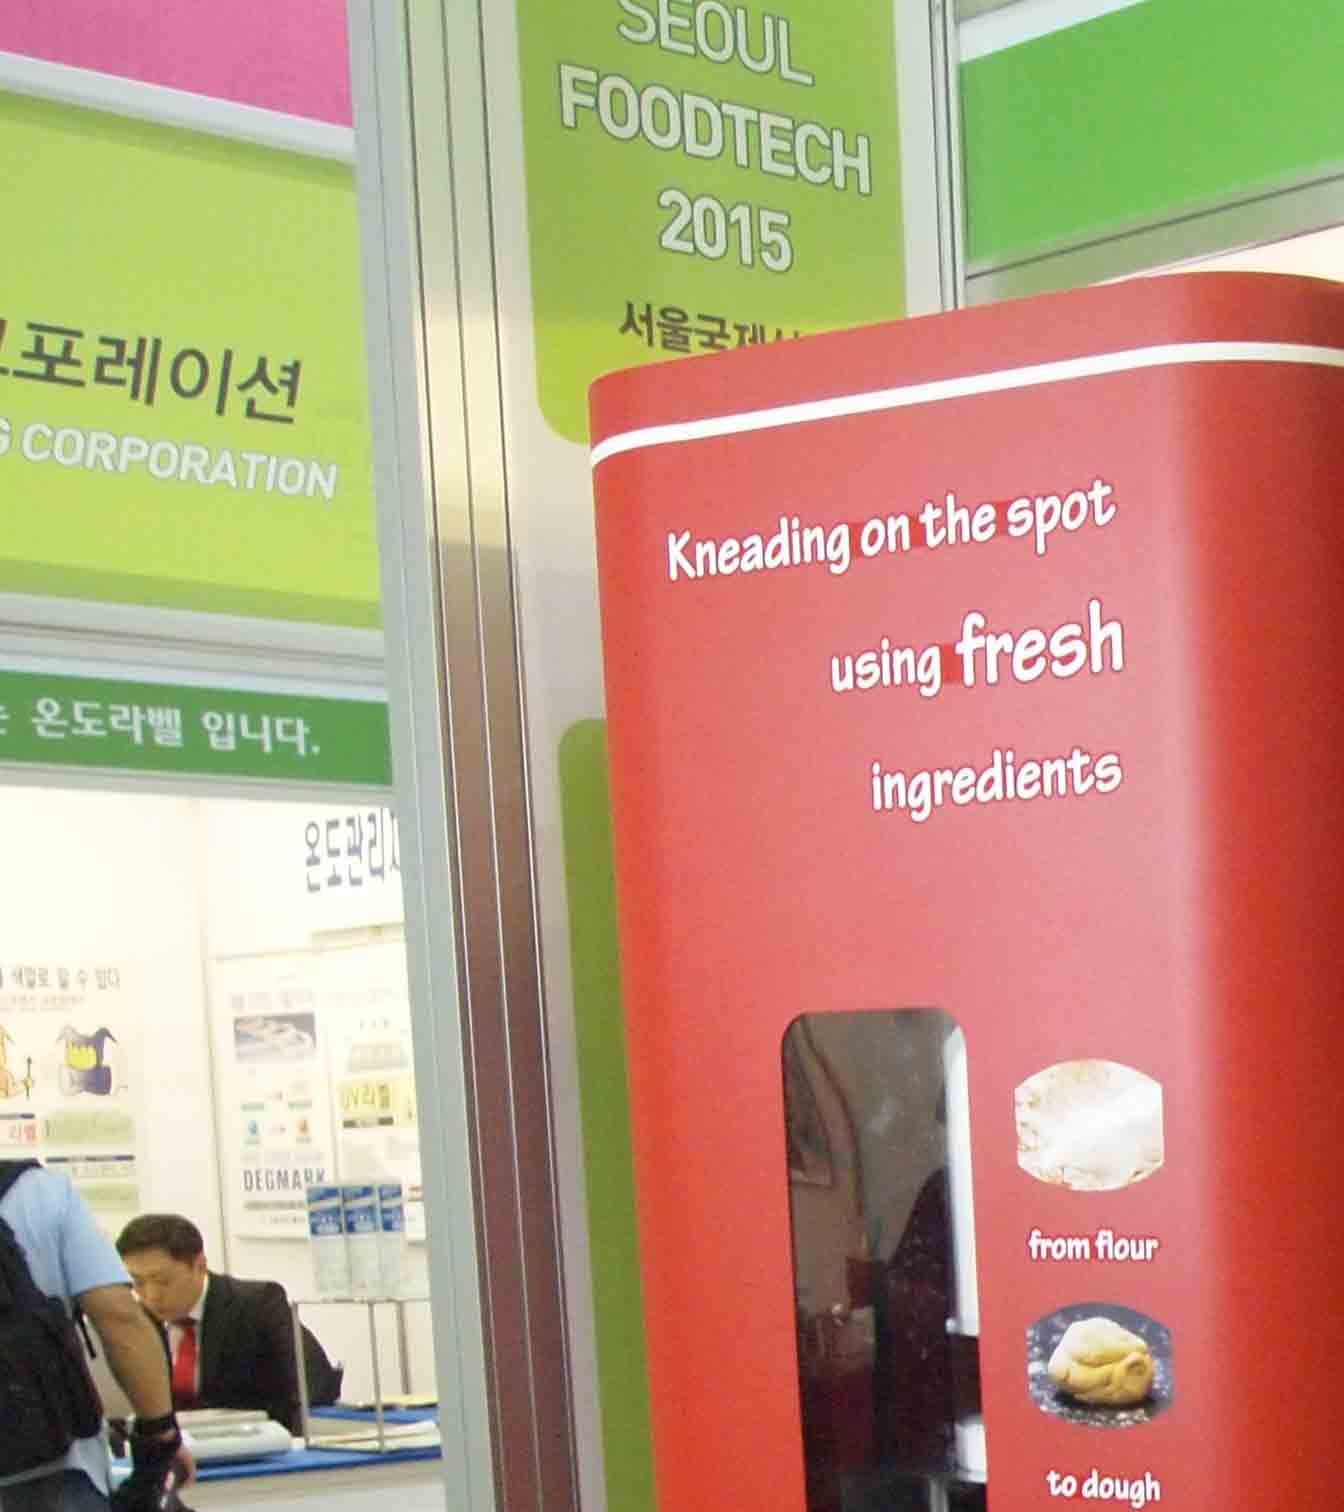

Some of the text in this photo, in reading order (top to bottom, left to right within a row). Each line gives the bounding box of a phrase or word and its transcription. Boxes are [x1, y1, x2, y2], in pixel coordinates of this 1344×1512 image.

[617, 0, 815, 86] SEOUL
[558, 63, 872, 195] FOODTECH
[657, 188, 793, 273] 2015
[618, 300, 800, 353] 서울국제
[22, 423, 338, 502] CORPORATION
[667, 478, 1118, 582] Kneading on the spot
[831, 598, 1125, 698] using fresh
[32, 697, 184, 749] 온도라벨
[202, 711, 321, 756] 입니다.
[871, 748, 1123, 822] ingredients
[1027, 1229, 1160, 1261] from flour
[1046, 1470, 1161, 1509] to dough
